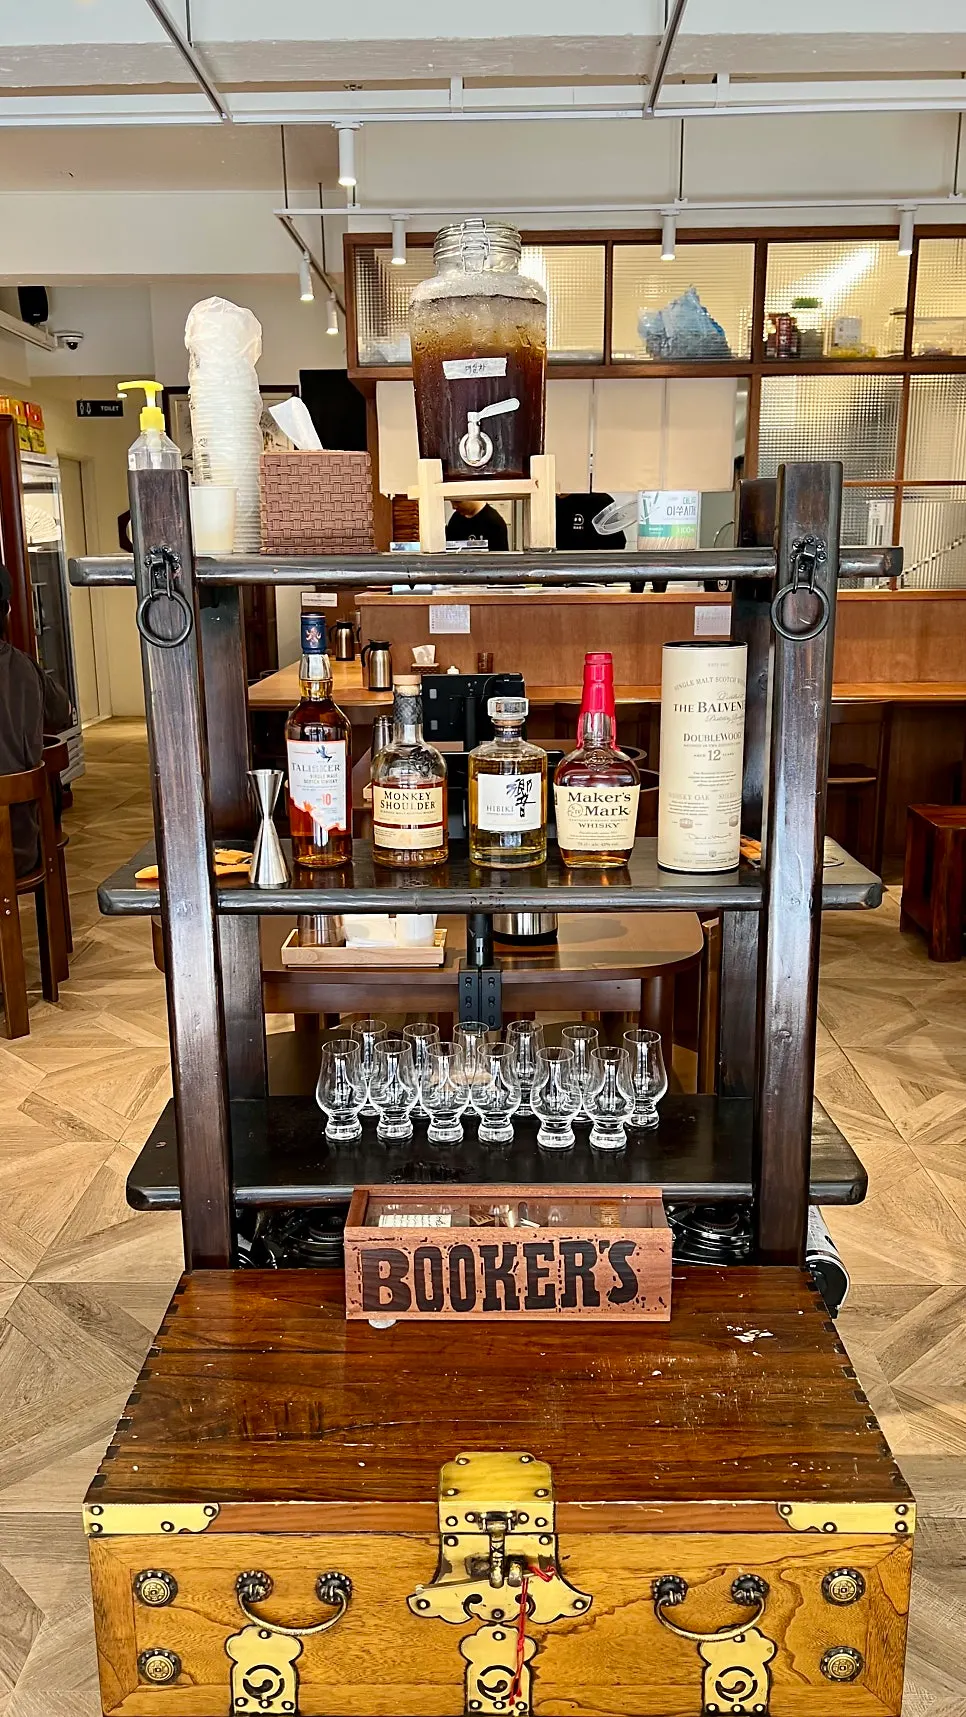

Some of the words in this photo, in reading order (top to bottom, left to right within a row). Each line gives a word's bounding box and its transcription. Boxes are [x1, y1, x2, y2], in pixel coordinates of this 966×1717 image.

[695, 676, 714, 684] MALT
[673, 703, 695, 713] THE
[707, 749, 721, 761] 12
[291, 762, 340, 772] TALISKER
[321, 793, 332, 806] 10
[384, 790, 431, 801] MONKEY
[567, 791, 631, 803] Maker's
[380, 799, 436, 810] SHOULDER
[486, 805, 514, 813] HIBIKI
[584, 805, 630, 817] Mark
[361, 1240, 639, 1312] BOOKER'S
